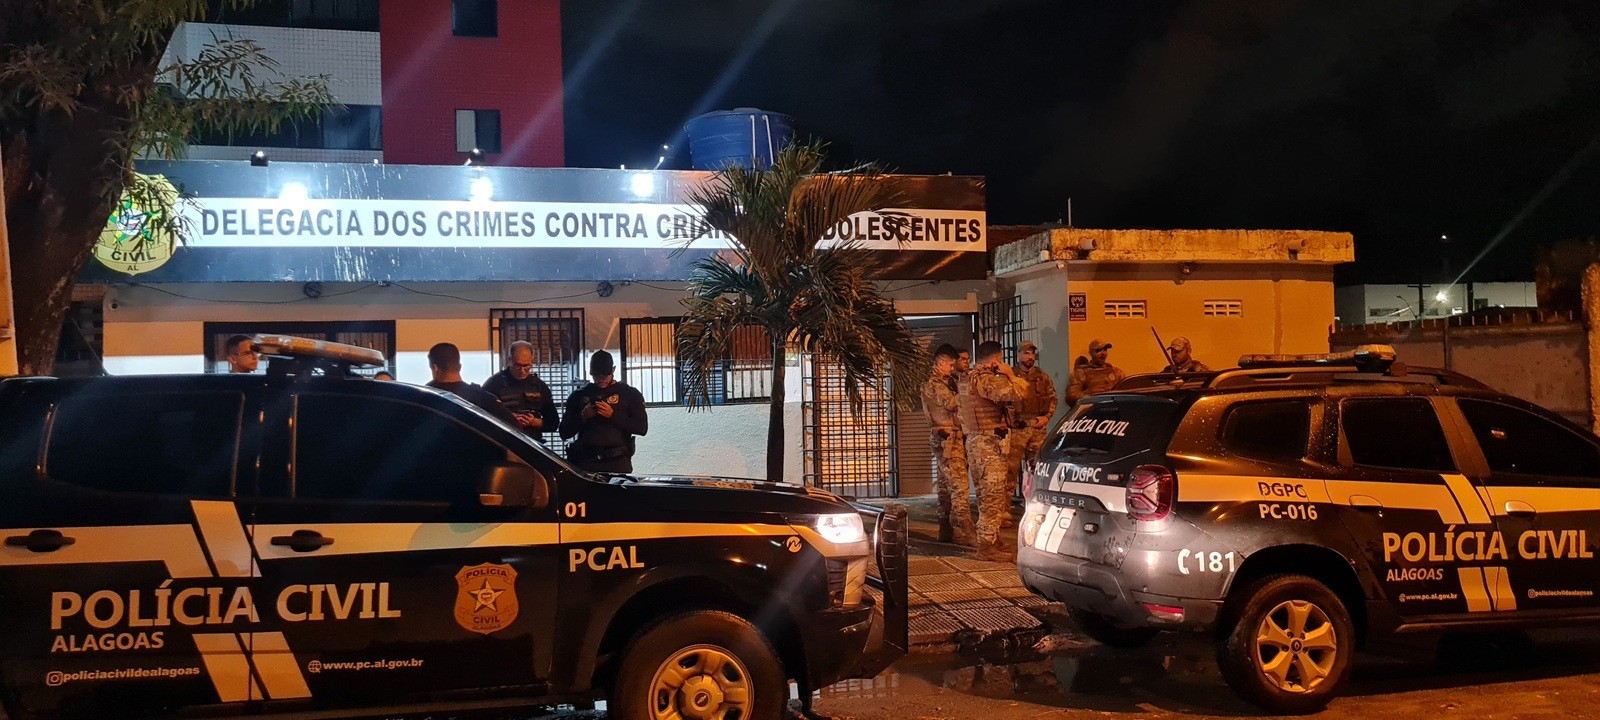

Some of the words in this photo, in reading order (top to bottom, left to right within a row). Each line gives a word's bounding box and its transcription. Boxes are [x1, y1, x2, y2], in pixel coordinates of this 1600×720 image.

[202, 208, 364, 236] DELEGACIA
[373, 210, 427, 237] DOS
[437, 210, 536, 237] CRIMES
[545, 212, 648, 238] CONTRA
[821, 215, 981, 243] DOLESCENTES
[111, 250, 156, 262] CIVIL
[1056, 415, 1097, 435] POLÍCIA
[1095, 420, 1129, 437] CIVIL
[1034, 461, 1051, 477] PCAL
[1071, 467, 1102, 483] DGPC
[1258, 482, 1308, 498] DGPC
[1037, 493, 1086, 507] DUSTER
[565, 502, 586, 517] 01
[1259, 503, 1318, 520] PC-016
[1382, 524, 1508, 562] POLÍCIA
[1518, 530, 1594, 560] CIVIL
[569, 545, 645, 572] PCAL
[1194, 551, 1235, 573] 181
[1386, 568, 1444, 581] ALAGOAS
[1406, 592, 1458, 600] www.pc.al.gov.br
[51, 579, 260, 630] POLÍCIA
[276, 582, 401, 622] CIVIL
[473, 616, 501, 624] CIVIL
[51, 631, 164, 652] ALAGOAS
[323, 658, 424, 671] www.pc.al.gov.br
[63, 667, 200, 683] policiacivildealagoas
